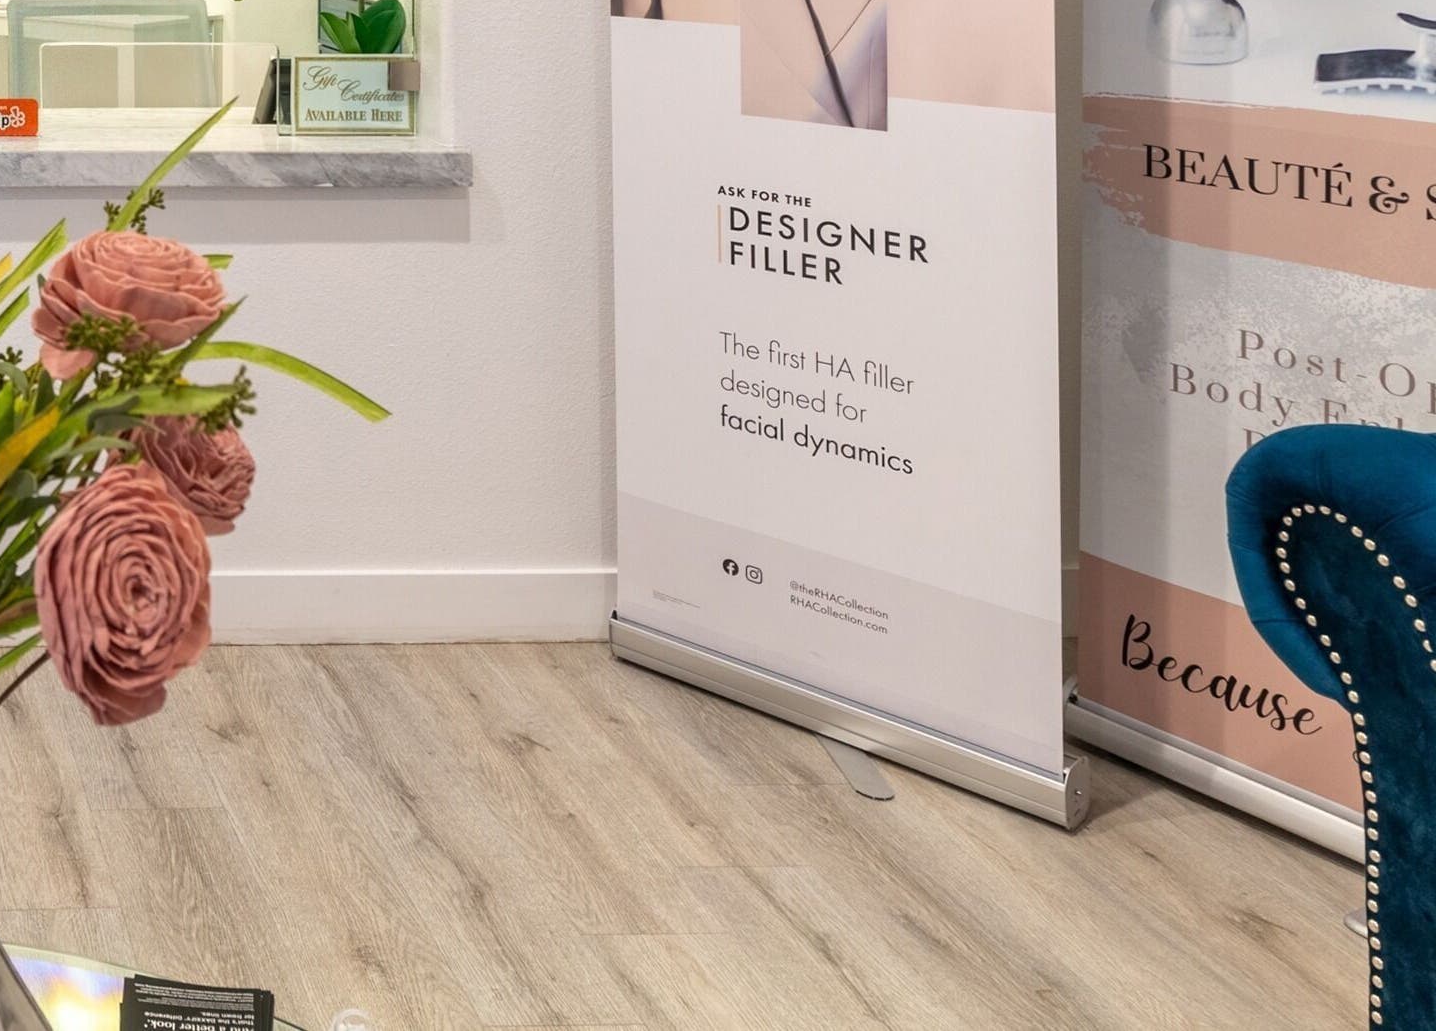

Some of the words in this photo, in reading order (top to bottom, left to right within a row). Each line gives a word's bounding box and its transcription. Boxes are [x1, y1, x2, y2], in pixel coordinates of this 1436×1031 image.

[302, 65, 338, 90] Gift
[337, 79, 405, 105] Certificates
[305, 108, 368, 122] AVAILABLE
[371, 108, 403, 122] HERE
[717, 185, 746, 200] ASK
[751, 189, 780, 204] FOR
[785, 193, 813, 208] THE
[1142, 143, 1354, 208] BEAUTÉ
[1368, 175, 1410, 215] &
[729, 206, 929, 264] DESIGNER
[729, 241, 844, 286] FILLER
[719, 331, 761, 361] The
[767, 340, 806, 371] first
[815, 351, 855, 383] HA
[863, 360, 915, 396] filler
[720, 369, 827, 414] designed
[835, 393, 868, 424] for
[1170, 362, 1296, 428] Body
[720, 404, 785, 443] facial
[793, 424, 915, 476] dynamics
[789, 579, 890, 621] @theRHACollection
[789, 595, 889, 635] RHACollection.com
[1121, 614, 1323, 736] Because
